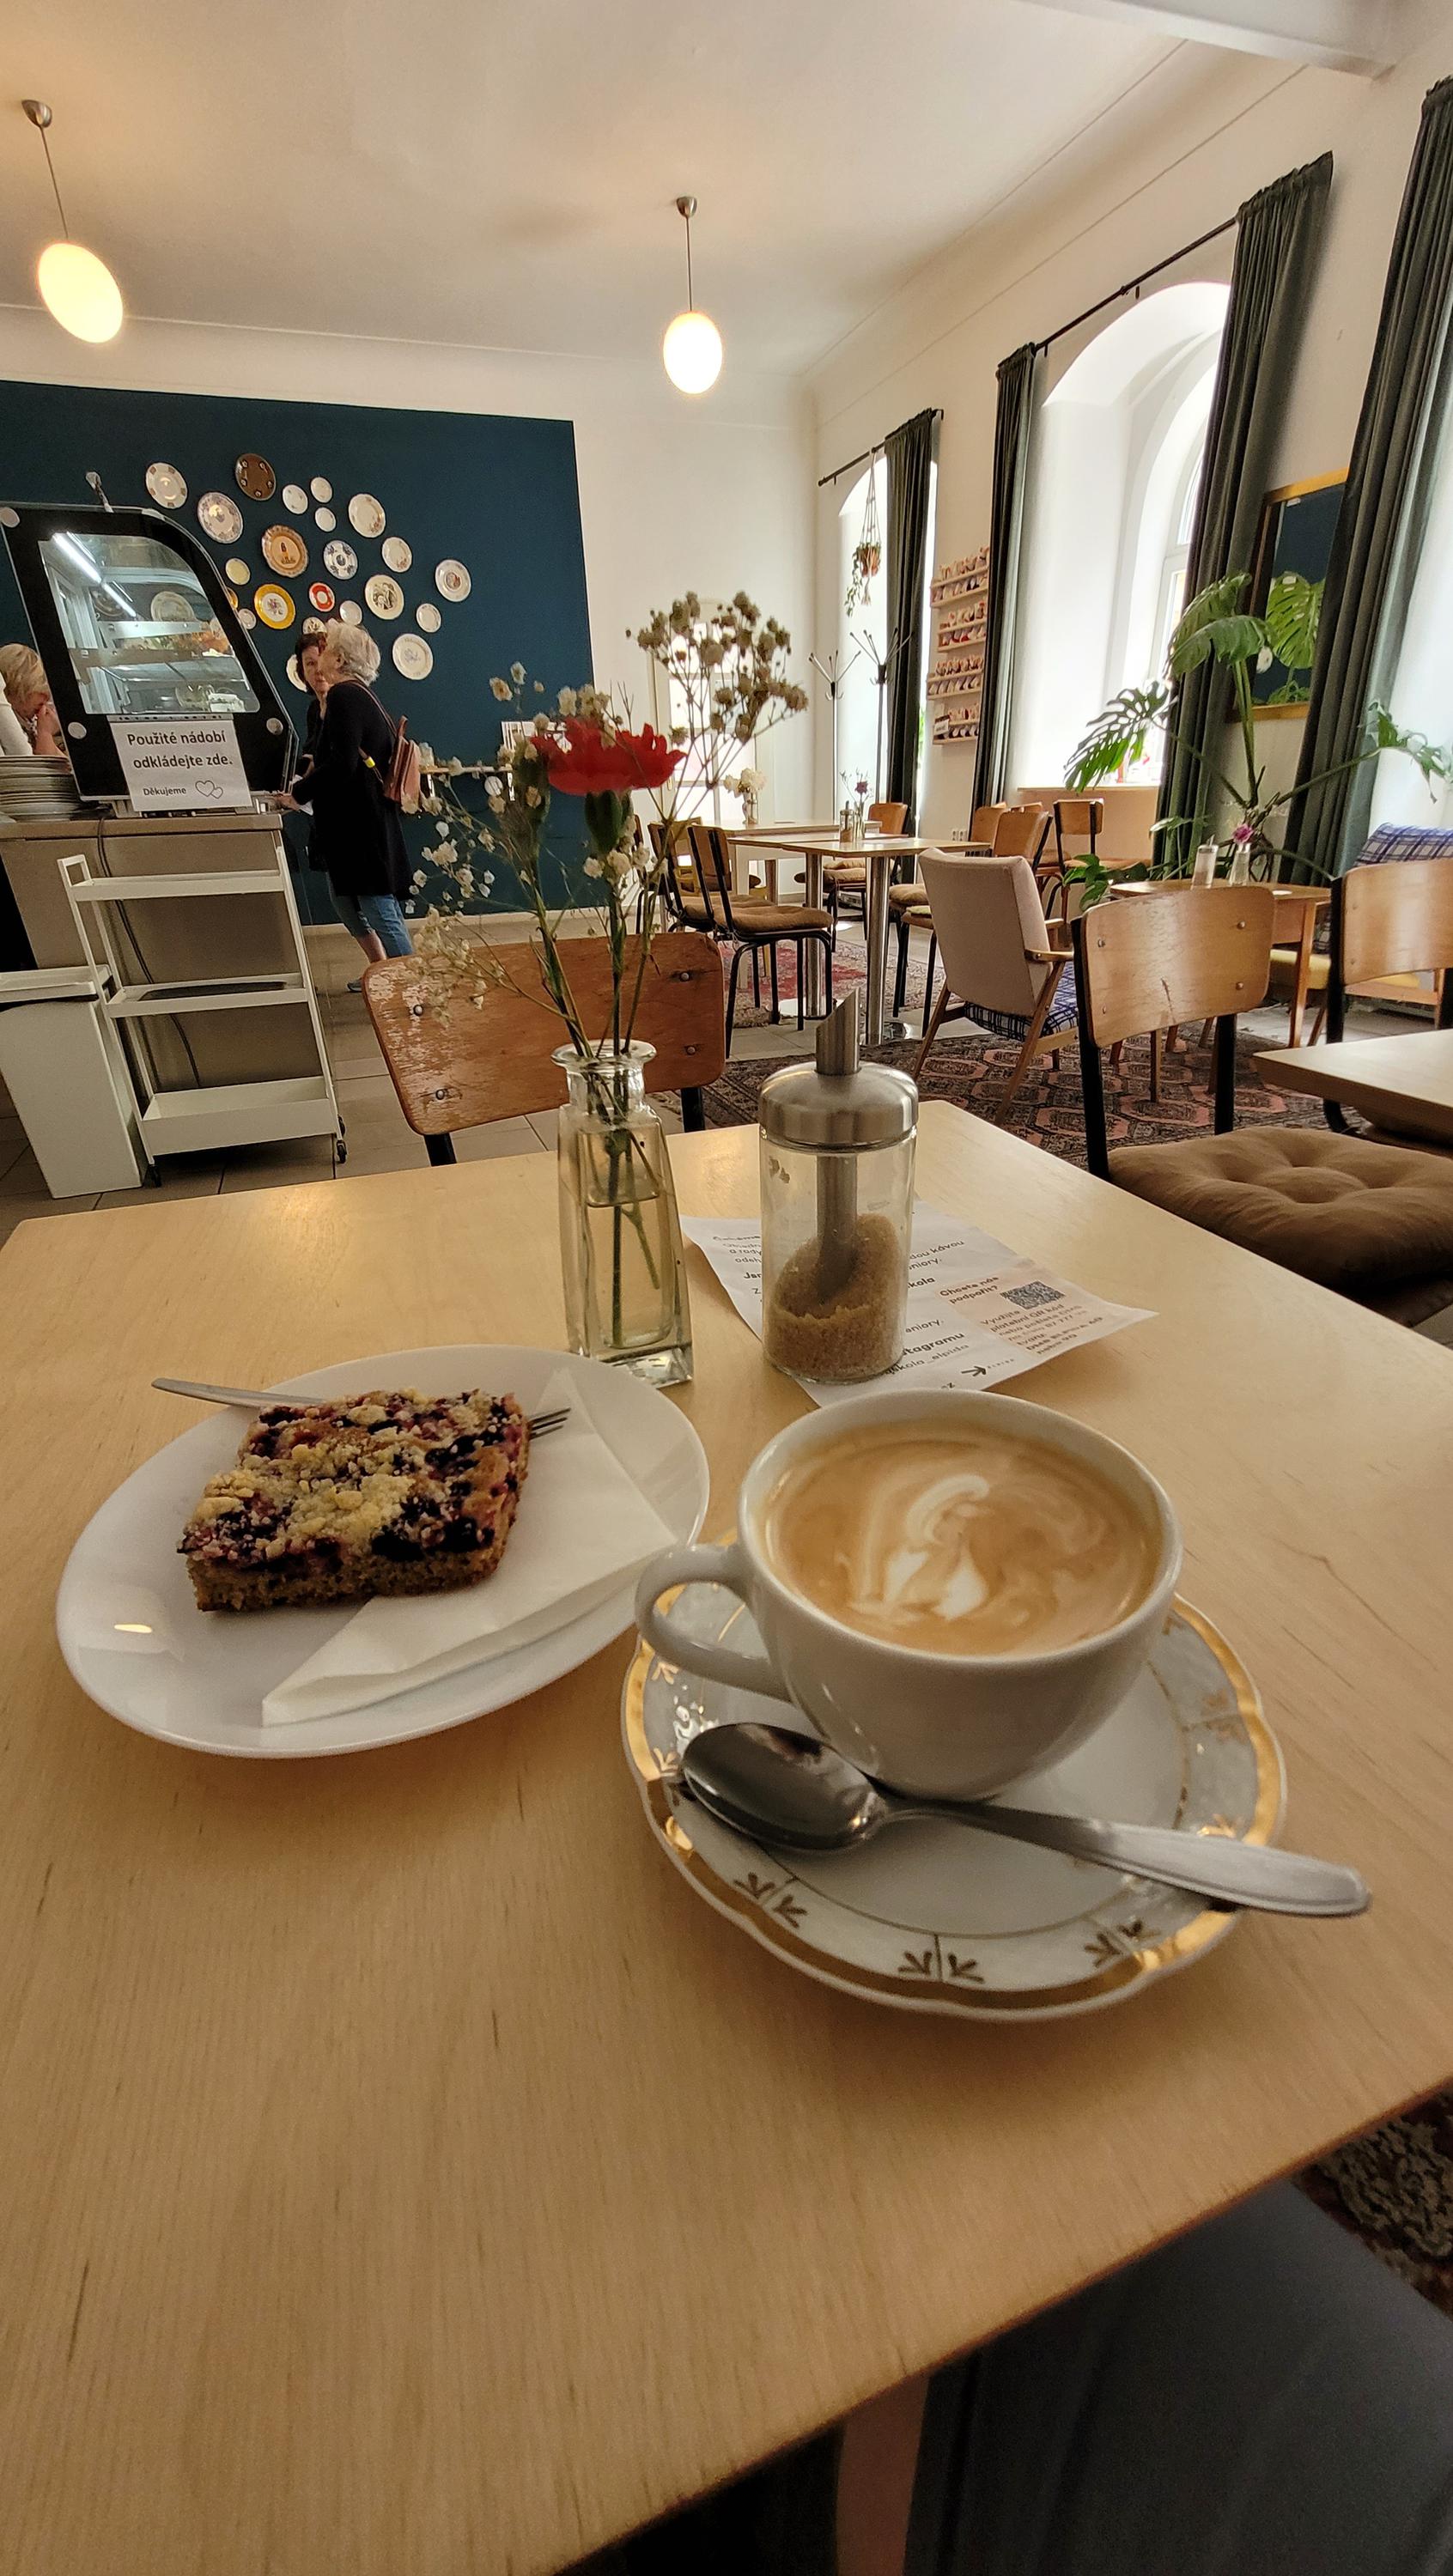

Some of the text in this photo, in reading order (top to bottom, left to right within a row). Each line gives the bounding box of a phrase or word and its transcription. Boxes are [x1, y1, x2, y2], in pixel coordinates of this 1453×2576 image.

[127, 730, 226, 745] Použité nádobí
[133, 753, 233, 769] odkládejte zde.
[143, 787, 187, 797] Děkujeme
[930, 1241, 964, 1254] kávou
[905, 1319, 944, 1334] eniory.
[902, 1333, 965, 1357] stagramu
